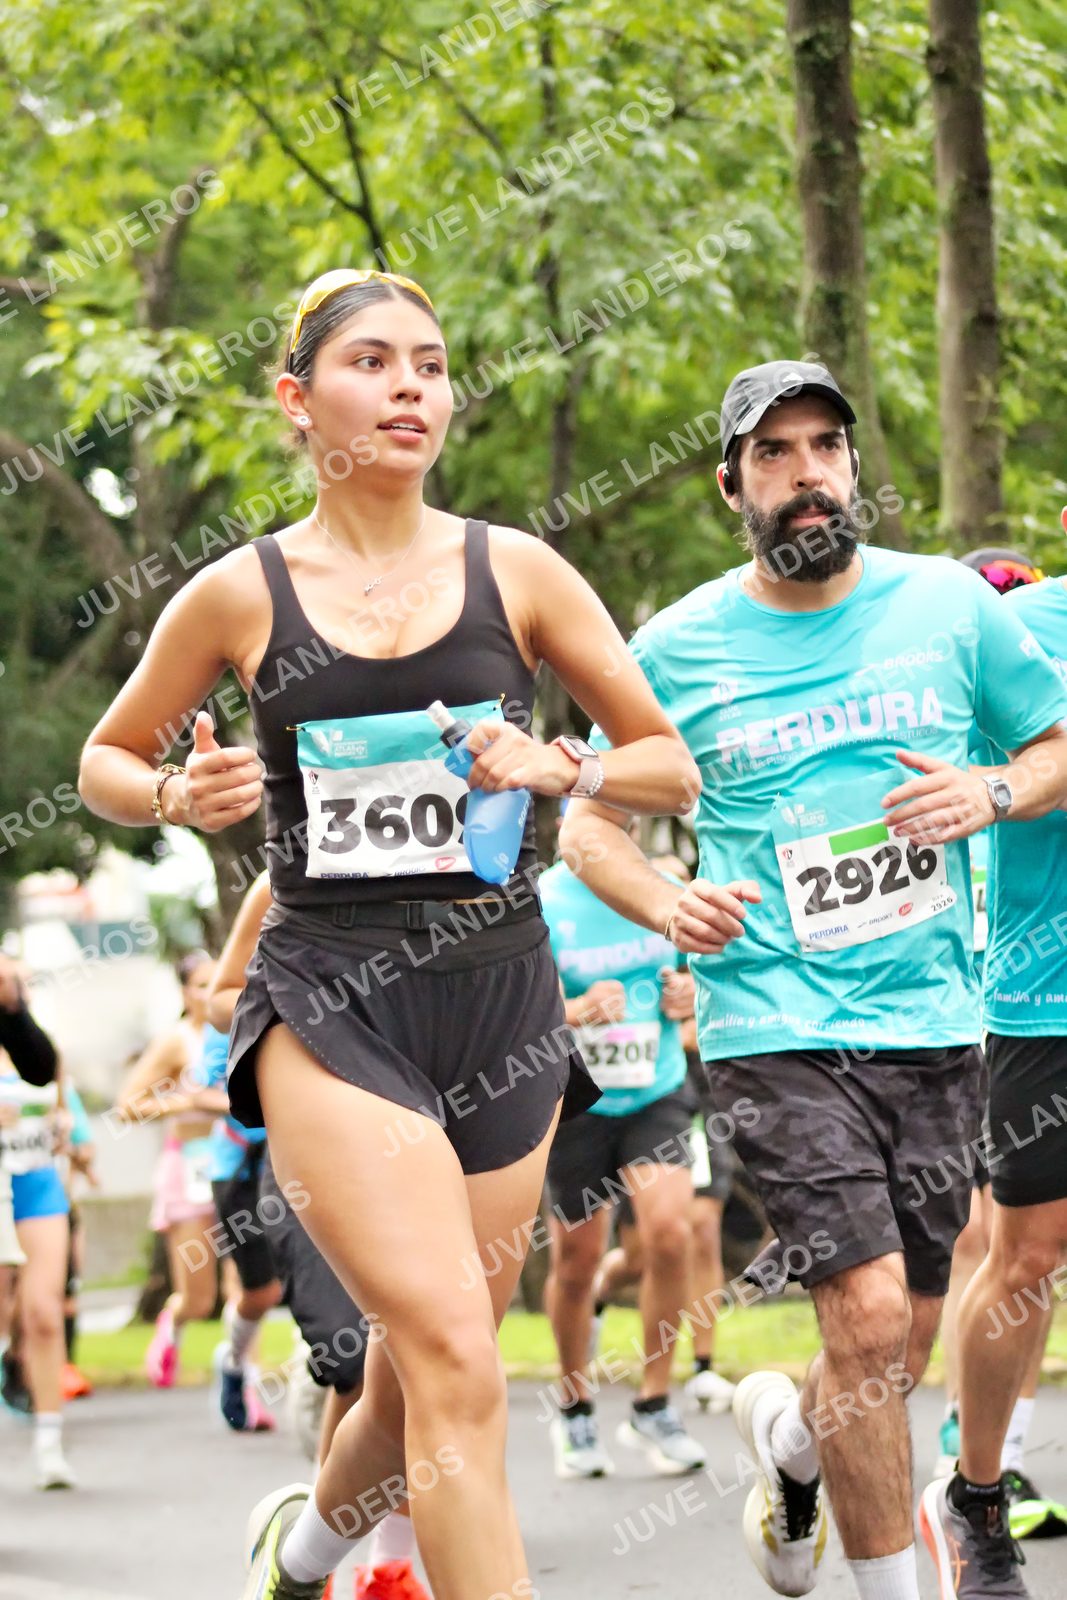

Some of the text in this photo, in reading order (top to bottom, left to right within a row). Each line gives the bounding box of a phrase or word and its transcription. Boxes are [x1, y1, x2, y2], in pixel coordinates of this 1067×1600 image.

[716, 686, 943, 764] PERDURA
[796, 838, 937, 916] 2926
[930, 896, 954, 912] 2926
[808, 923, 850, 941] PERDURA
[1034, 993, 1041, 1007] y
